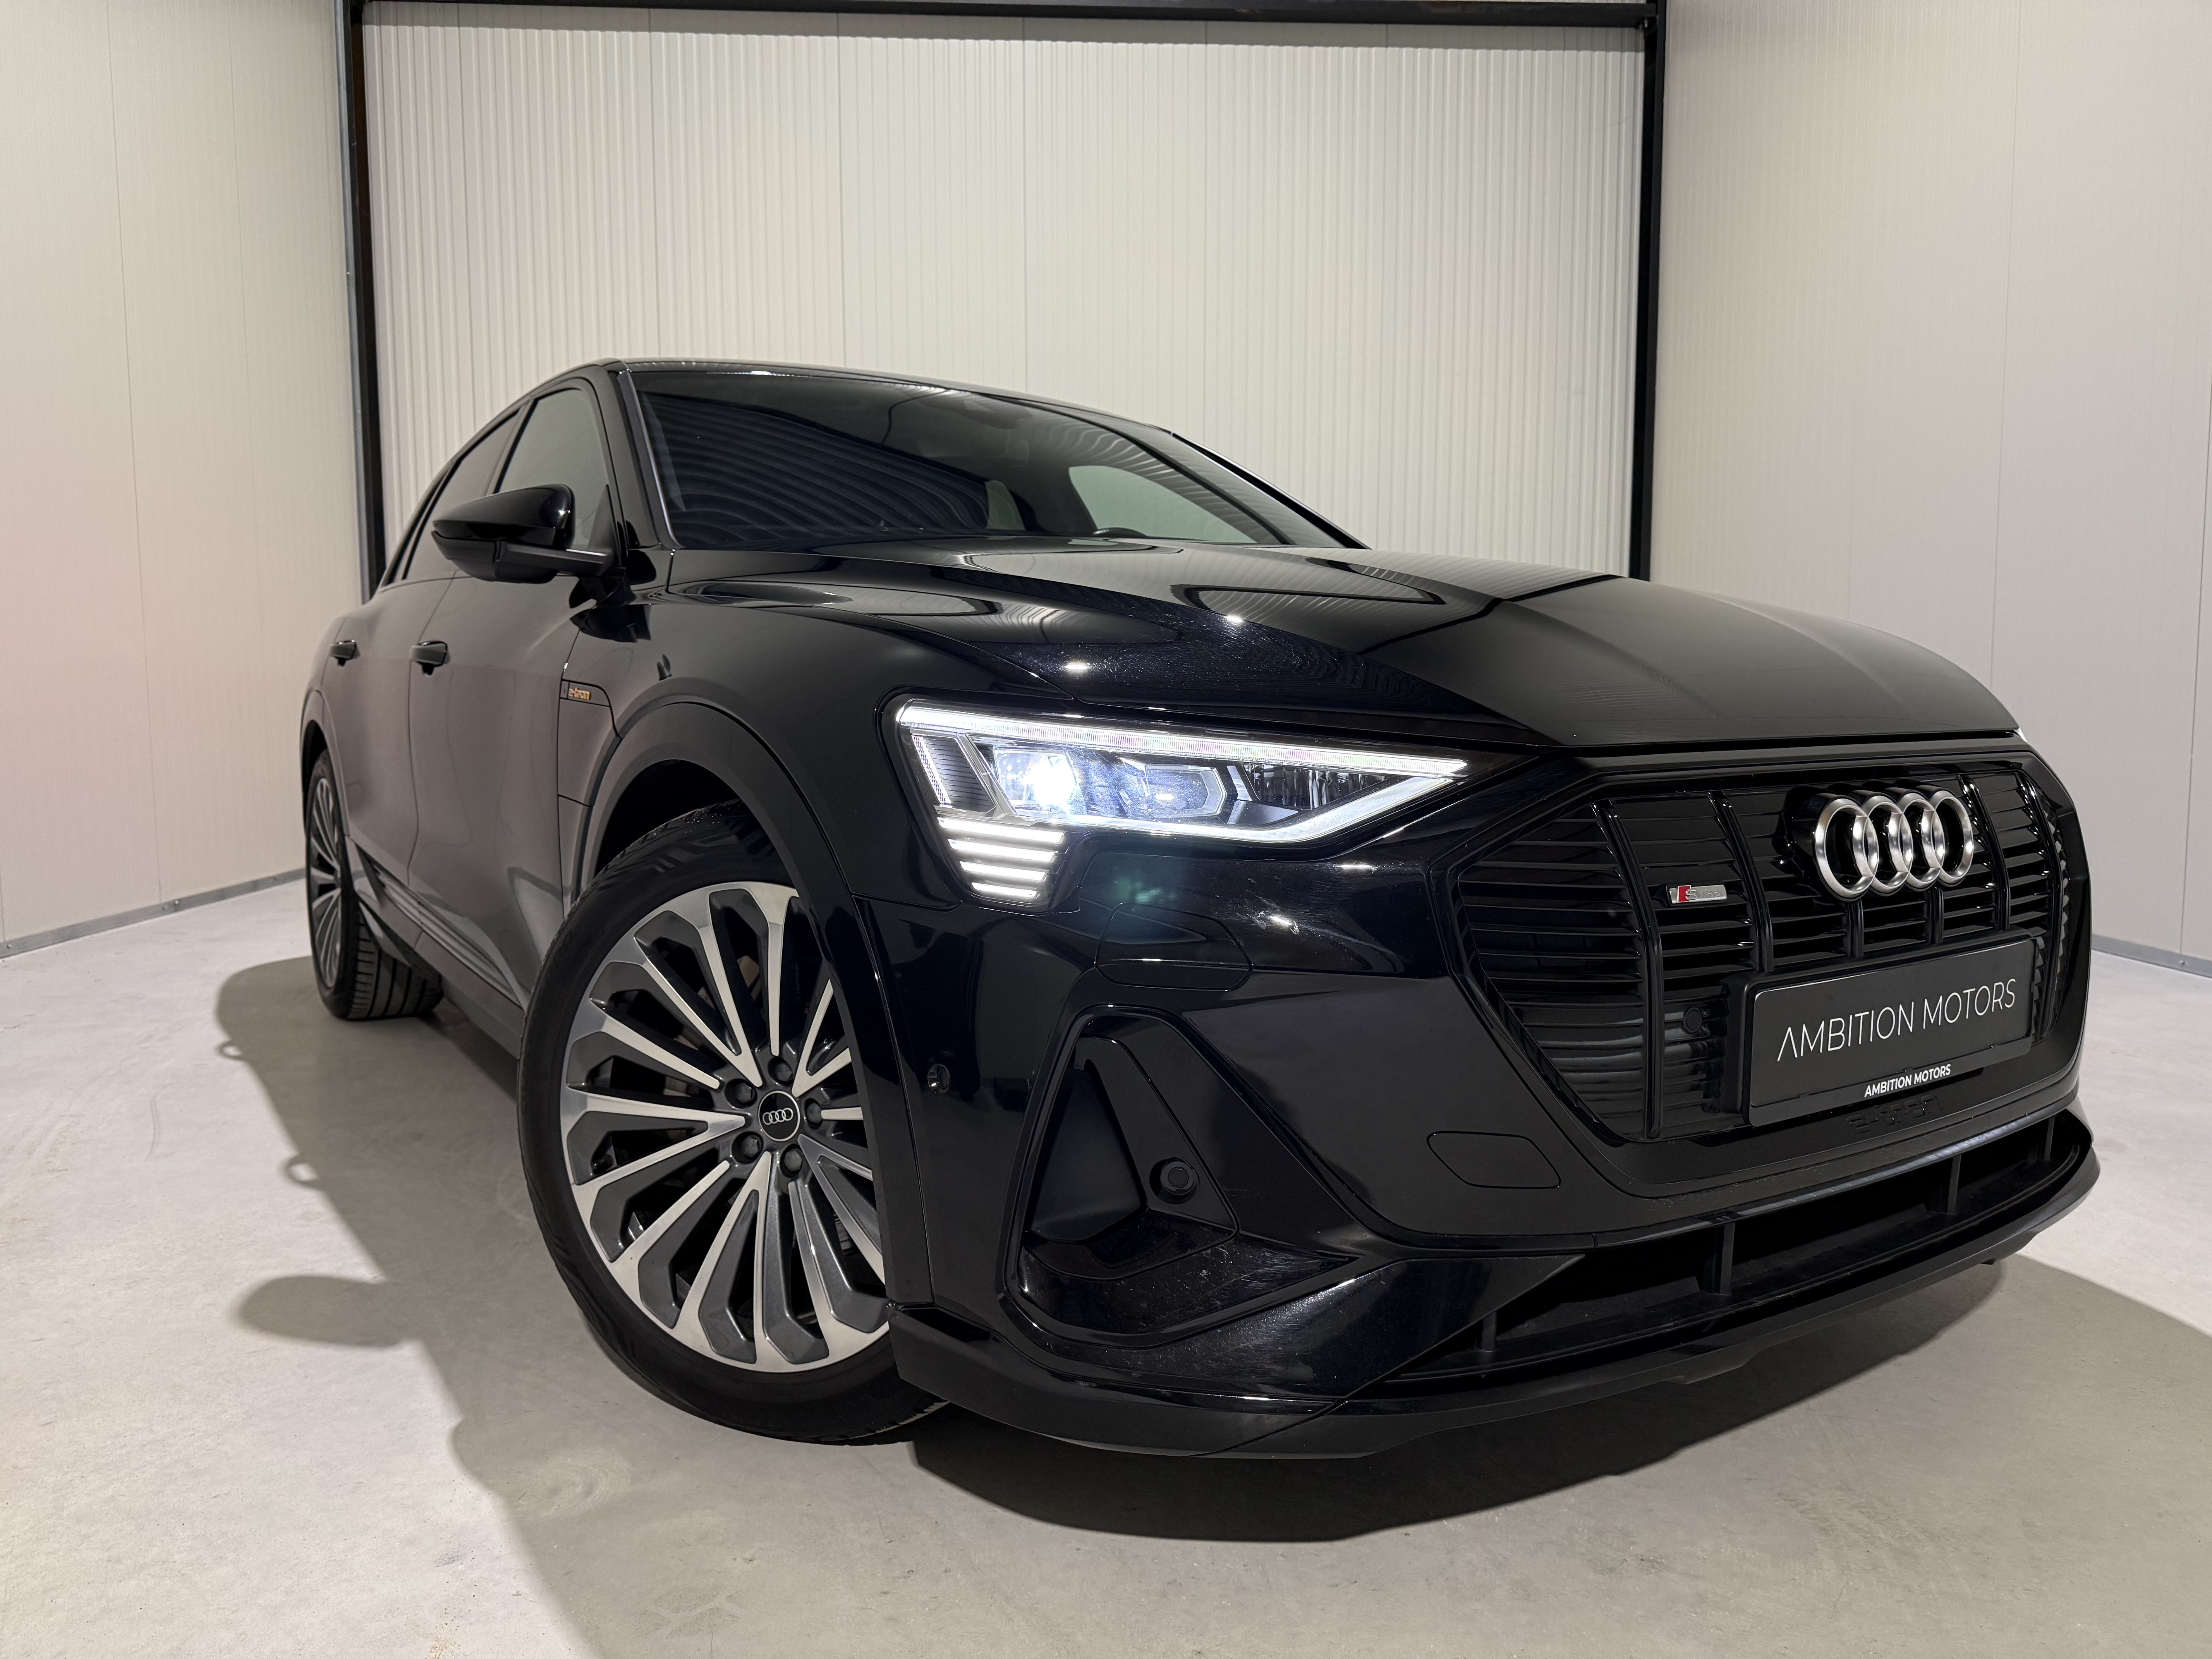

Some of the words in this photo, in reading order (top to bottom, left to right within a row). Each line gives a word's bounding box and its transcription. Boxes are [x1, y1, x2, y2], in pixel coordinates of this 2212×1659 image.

[1685, 889, 1697, 900] S
[1777, 1001, 1914, 1062] AMBITION
[1923, 978, 2016, 1029] MOTORS
[1864, 1074, 1912, 1097] AMBITION
[1914, 1063, 1951, 1085] MOTORS
